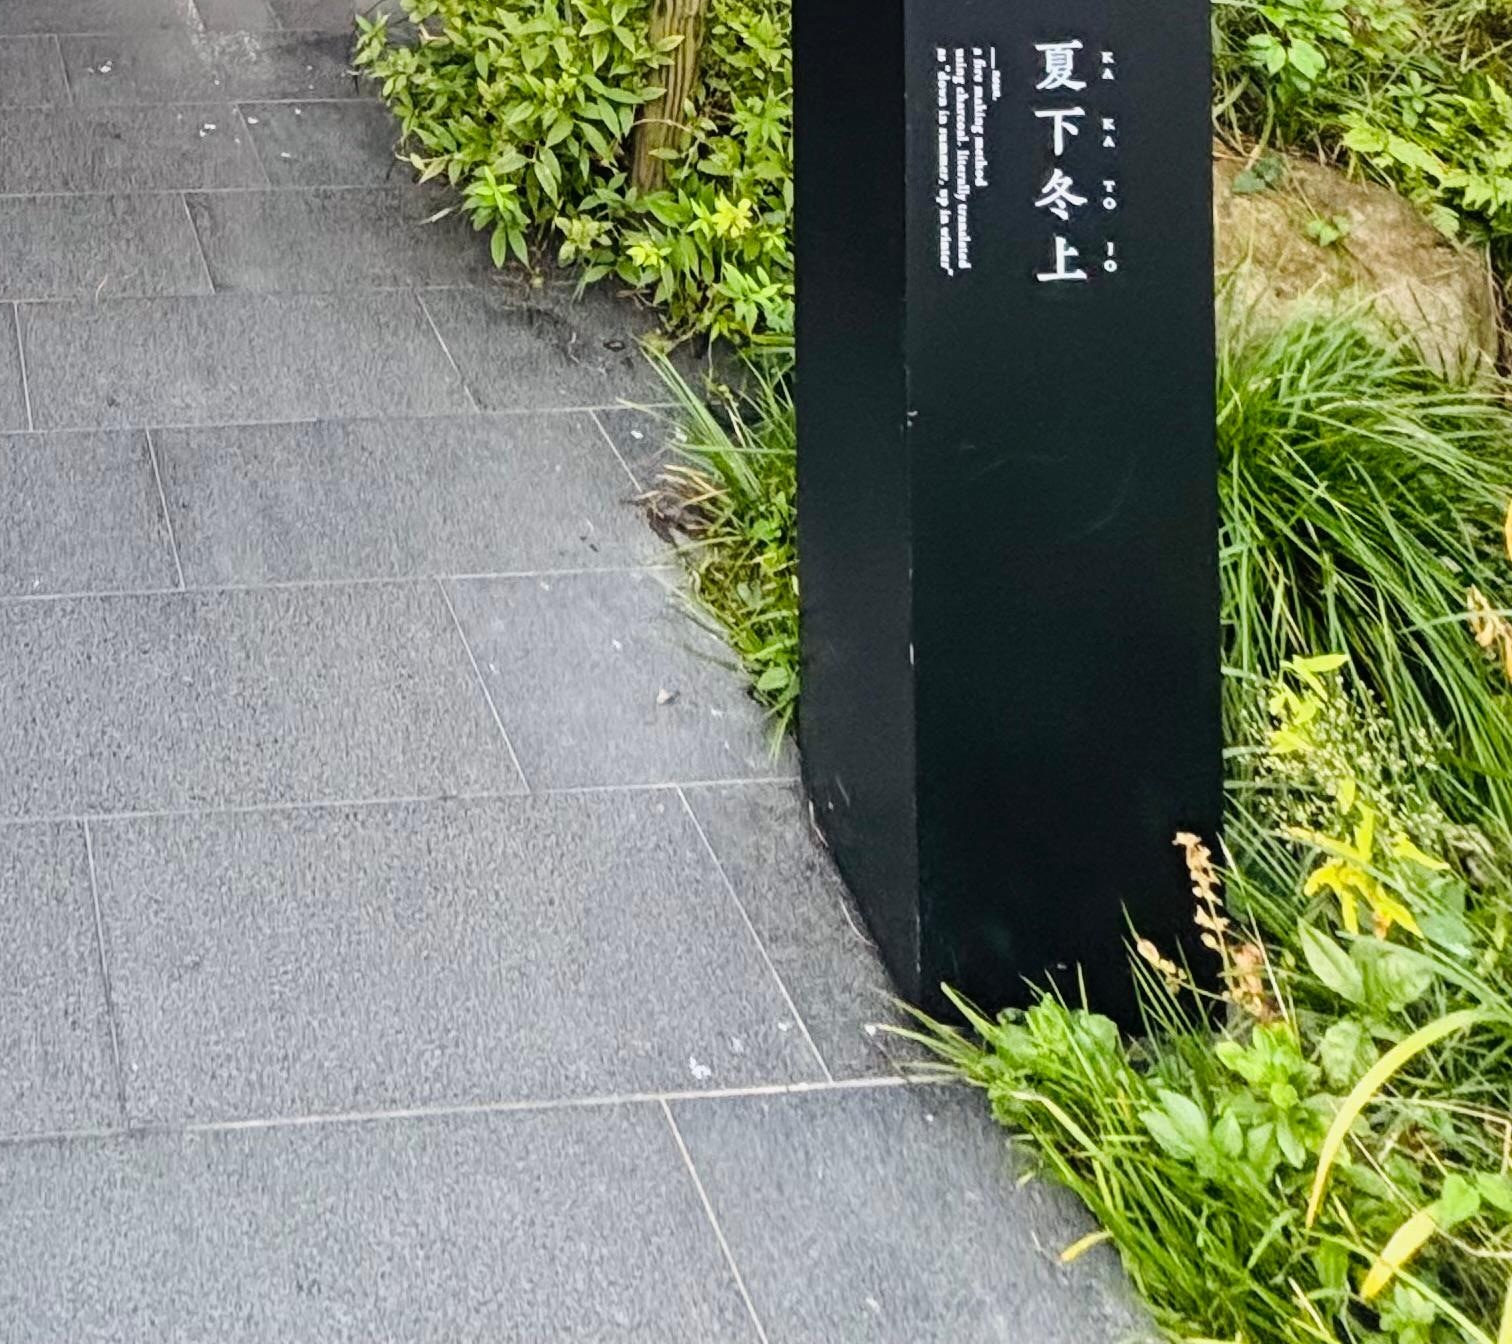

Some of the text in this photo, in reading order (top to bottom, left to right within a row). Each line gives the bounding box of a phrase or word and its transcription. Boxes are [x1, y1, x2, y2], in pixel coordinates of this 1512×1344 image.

[936, 47, 947, 63] as
[952, 47, 968, 85] using
[938, 109, 951, 125] in
[970, 85, 988, 135] making
[954, 149, 971, 202] literally
[973, 136, 989, 187] method
[1033, 38, 1089, 282] 夏下冬上
[935, 188, 950, 208] up
[939, 208, 952, 225] in
[956, 203, 972, 269] translated
